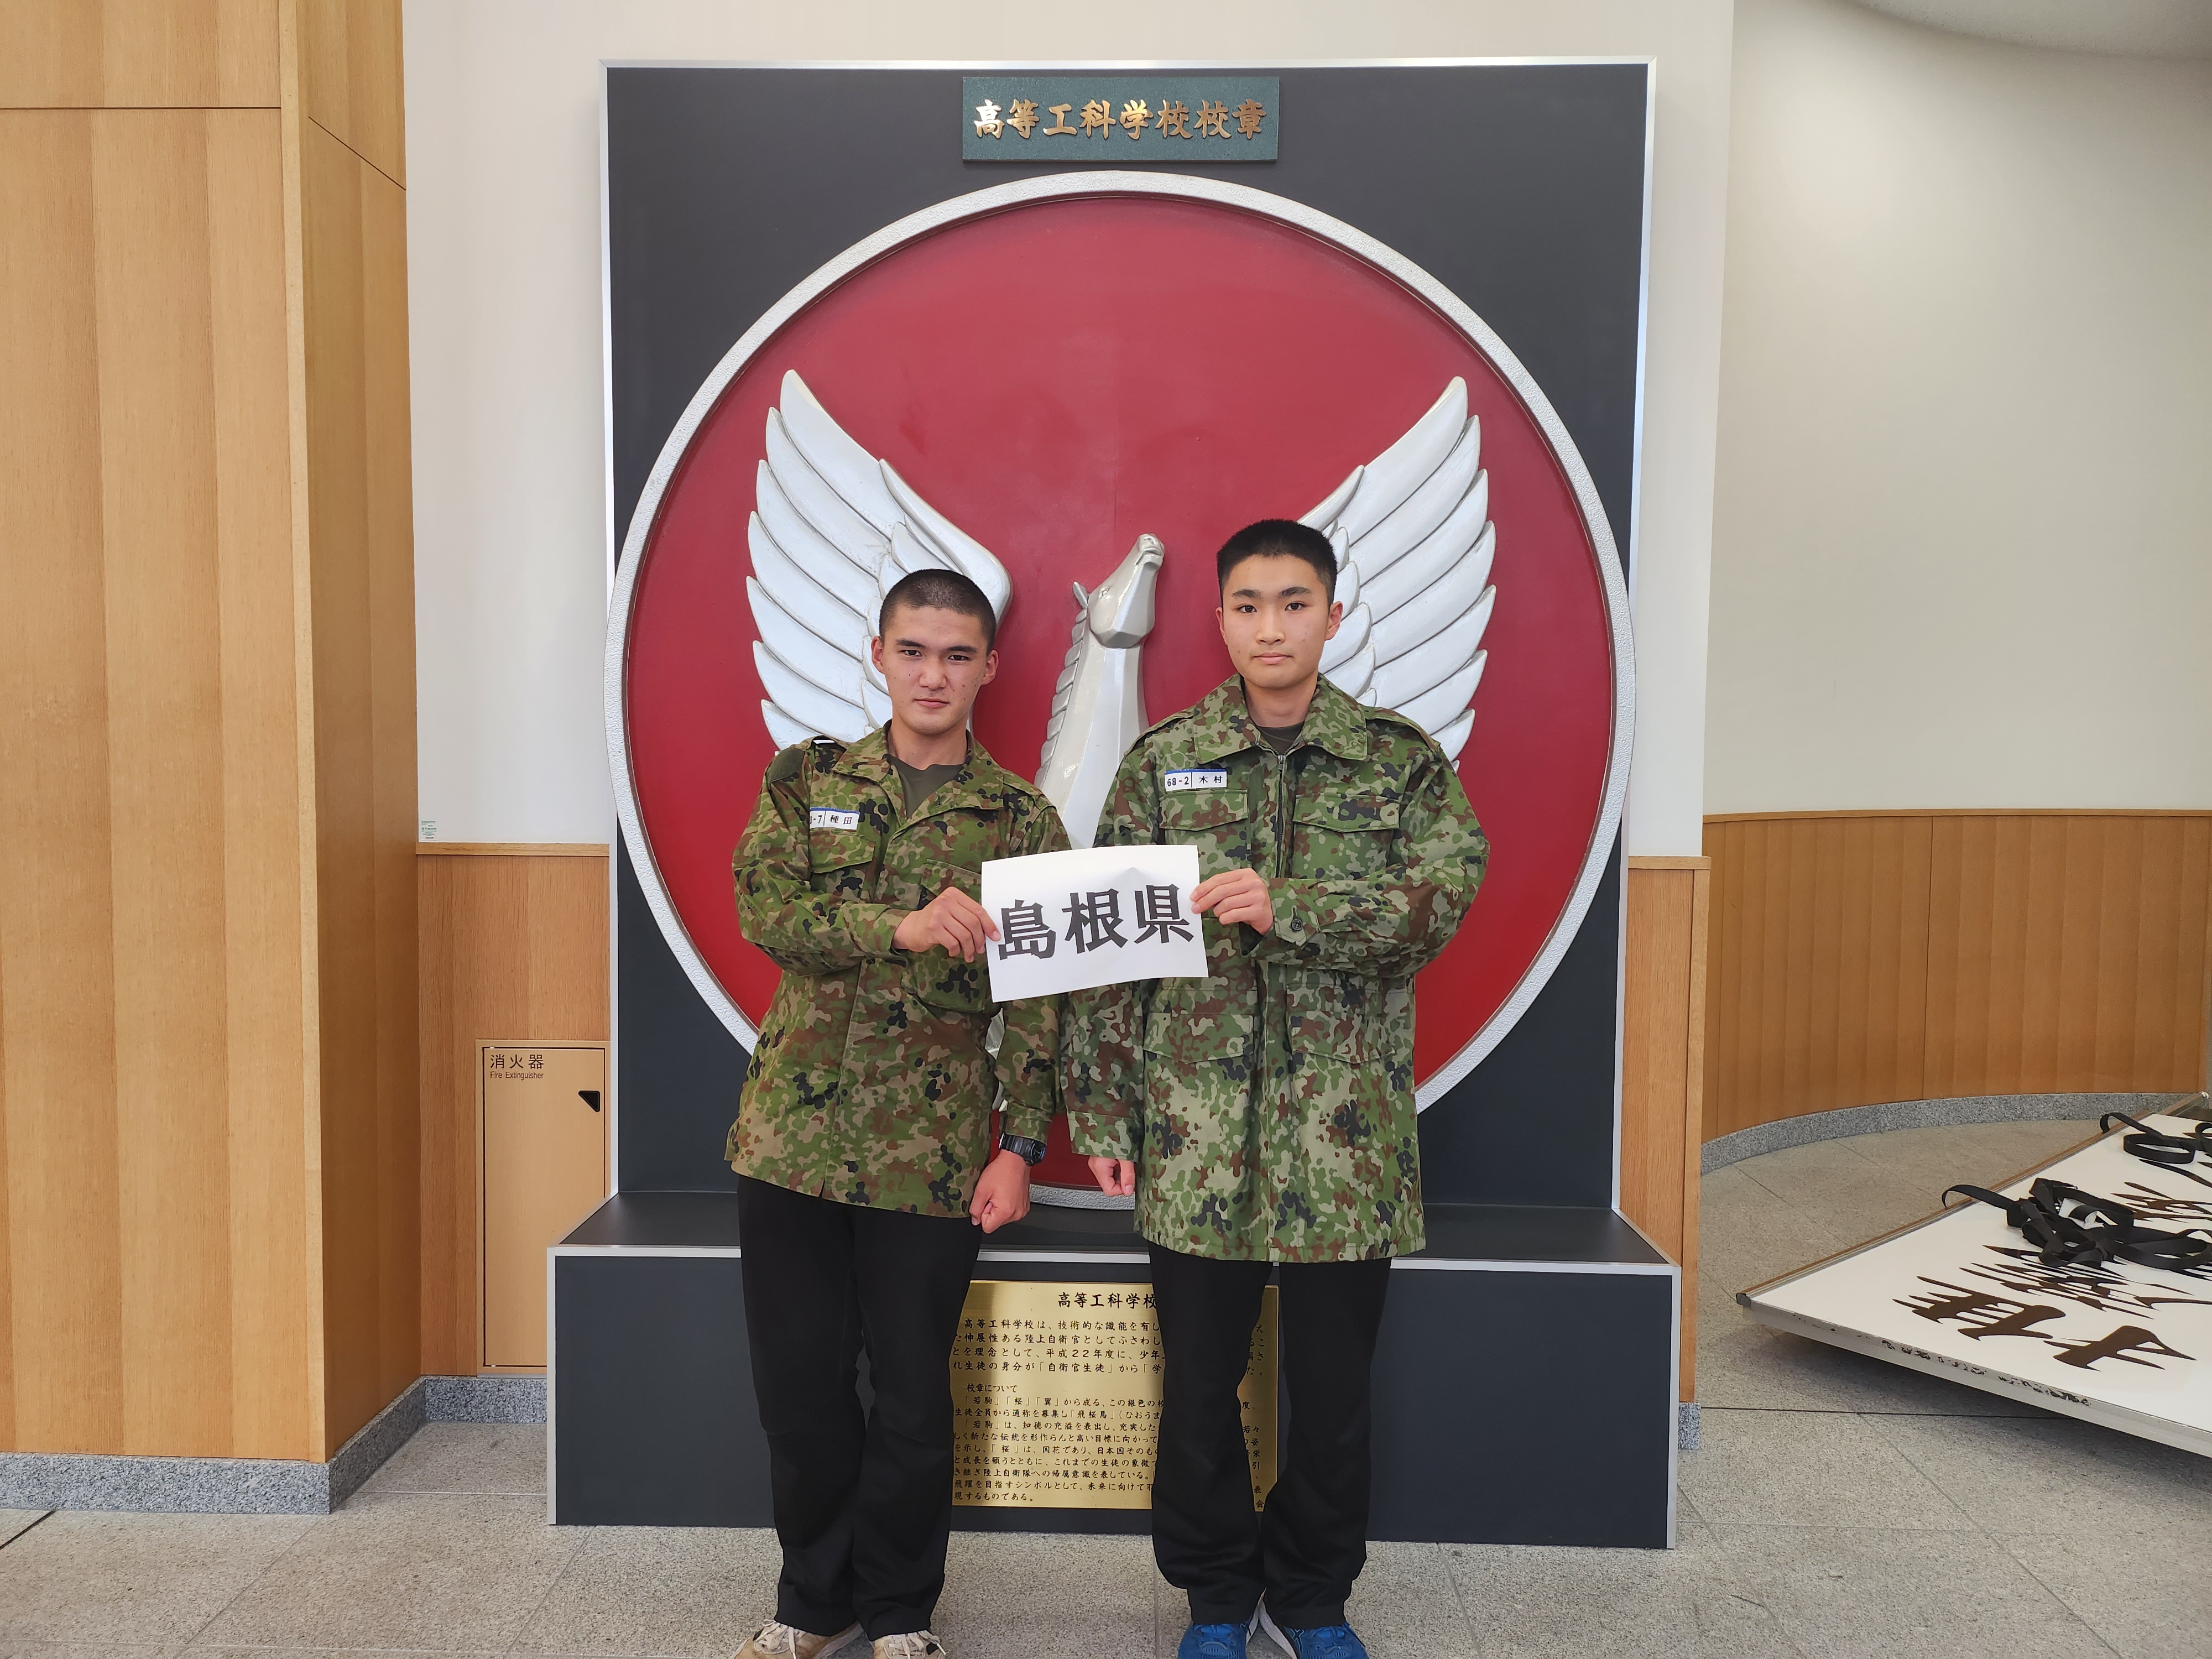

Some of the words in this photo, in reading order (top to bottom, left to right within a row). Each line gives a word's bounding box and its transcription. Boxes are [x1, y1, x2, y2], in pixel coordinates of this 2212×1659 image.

[973, 98, 1266, 139] 高等工科学校校章
[1167, 776, 1189, 786] 68-2
[1199, 775, 1223, 784] 木村
[998, 883, 1194, 961] 島根県
[490, 1053, 544, 1069] 消火器
[505, 1071, 544, 1081] Extinguisher
[1058, 1292, 1157, 1309] 高等工科学校
[967, 1383, 1018, 1392] 校章について
[954, 1492, 1033, 1501] 現するものである。
